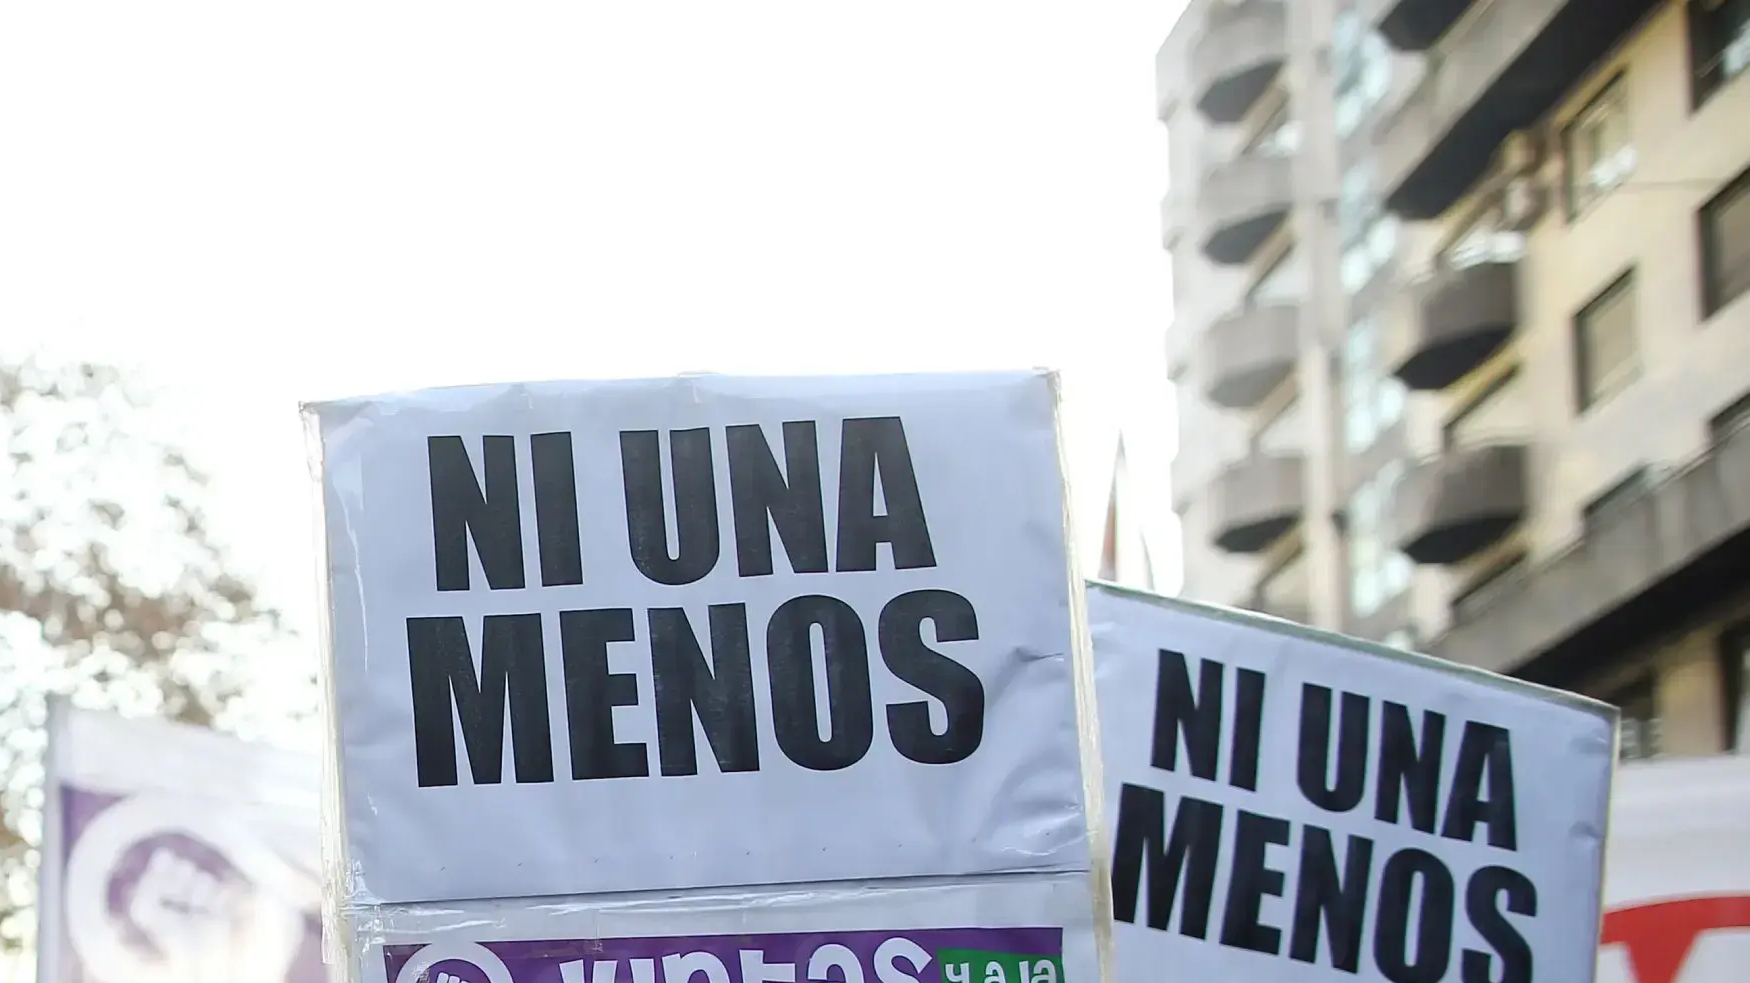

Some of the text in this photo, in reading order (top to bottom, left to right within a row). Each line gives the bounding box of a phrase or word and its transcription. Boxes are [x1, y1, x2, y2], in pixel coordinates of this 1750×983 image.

[427, 416, 937, 592] NI UNA
[406, 590, 984, 787] MENOS
[1150, 648, 1517, 851] NI UNA
